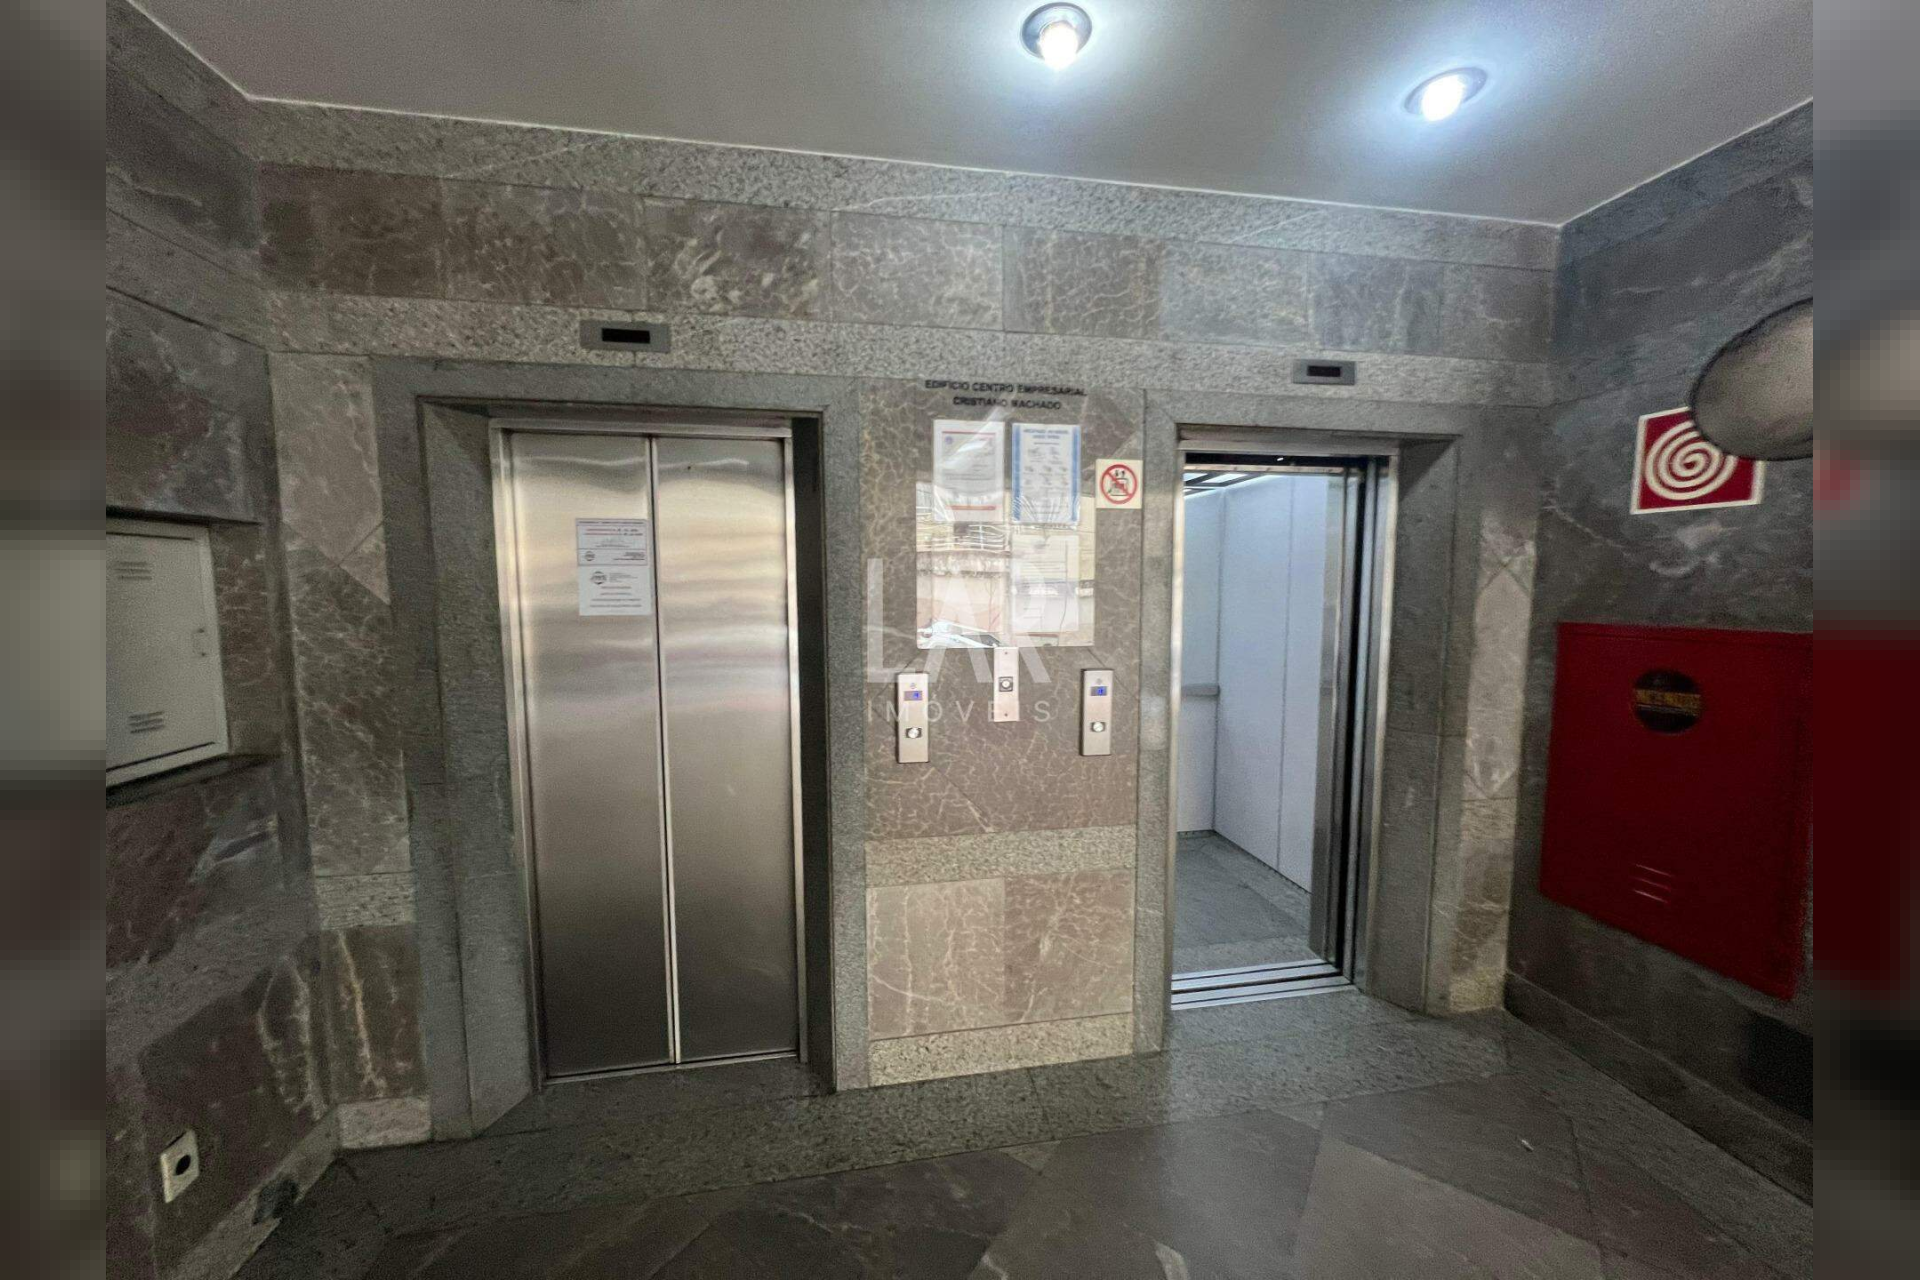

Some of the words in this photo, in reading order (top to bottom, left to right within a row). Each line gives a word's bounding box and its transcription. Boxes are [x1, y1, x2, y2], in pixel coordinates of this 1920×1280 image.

[971, 382, 1014, 393] CENTRO
[1017, 384, 1087, 397] EMPRESARIAL
[953, 396, 1008, 408] CRISTIANO
[1011, 398, 1062, 410] MACHADO
